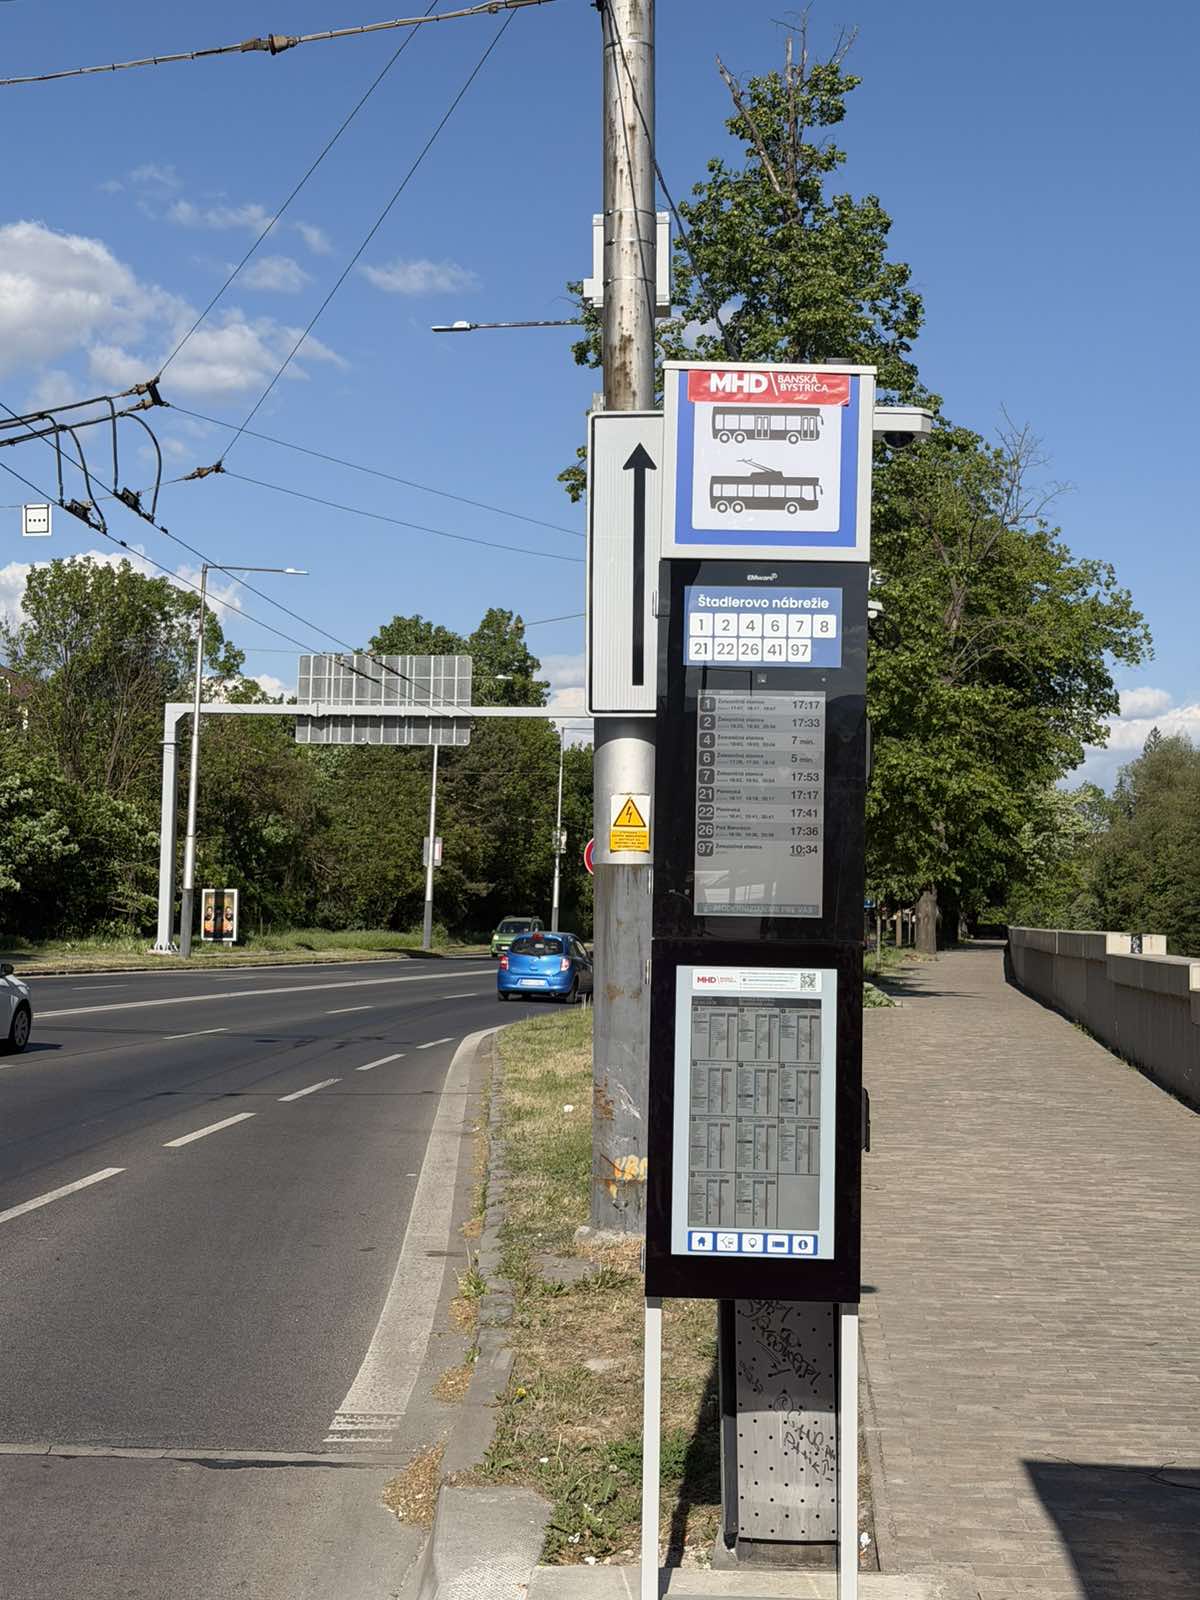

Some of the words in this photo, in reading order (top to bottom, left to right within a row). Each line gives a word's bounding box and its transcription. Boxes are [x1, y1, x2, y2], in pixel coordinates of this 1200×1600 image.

[710, 372, 769, 393] MHD
[777, 374, 817, 383] BANSKÁ
[780, 383, 829, 393] BYSTRICA
[698, 594, 769, 608] Štadlerovo
[772, 596, 830, 609] nábrežie
[698, 618, 704, 631] 1
[721, 619, 731, 632] 2
[745, 619, 756, 632] 4
[770, 619, 780, 632] 6
[795, 620, 804, 632] 7
[819, 620, 829, 633] 8
[693, 642, 708, 655] 21
[716, 642, 735, 656] 22
[740, 643, 759, 656] 26
[767, 643, 783, 656] 41
[791, 644, 809, 657] 97
[792, 700, 821, 710] 17:17
[703, 717, 713, 727] 2
[792, 718, 821, 728] 17:33
[703, 735, 713, 745] 4
[791, 735, 798, 745] 7
[702, 753, 712, 763] 6
[791, 754, 798, 763] 5
[702, 771, 711, 781] 7
[791, 772, 820, 782] 17:53
[698, 788, 713, 800] 21
[791, 790, 819, 800] 17:17
[698, 806, 714, 818] 22
[790, 808, 818, 818] 17:41
[697, 824, 714, 836] 26
[790, 826, 819, 837] 17:36
[697, 842, 713, 854] 97
[790, 844, 818, 855] 10:34
[696, 975, 717, 984] MHD
